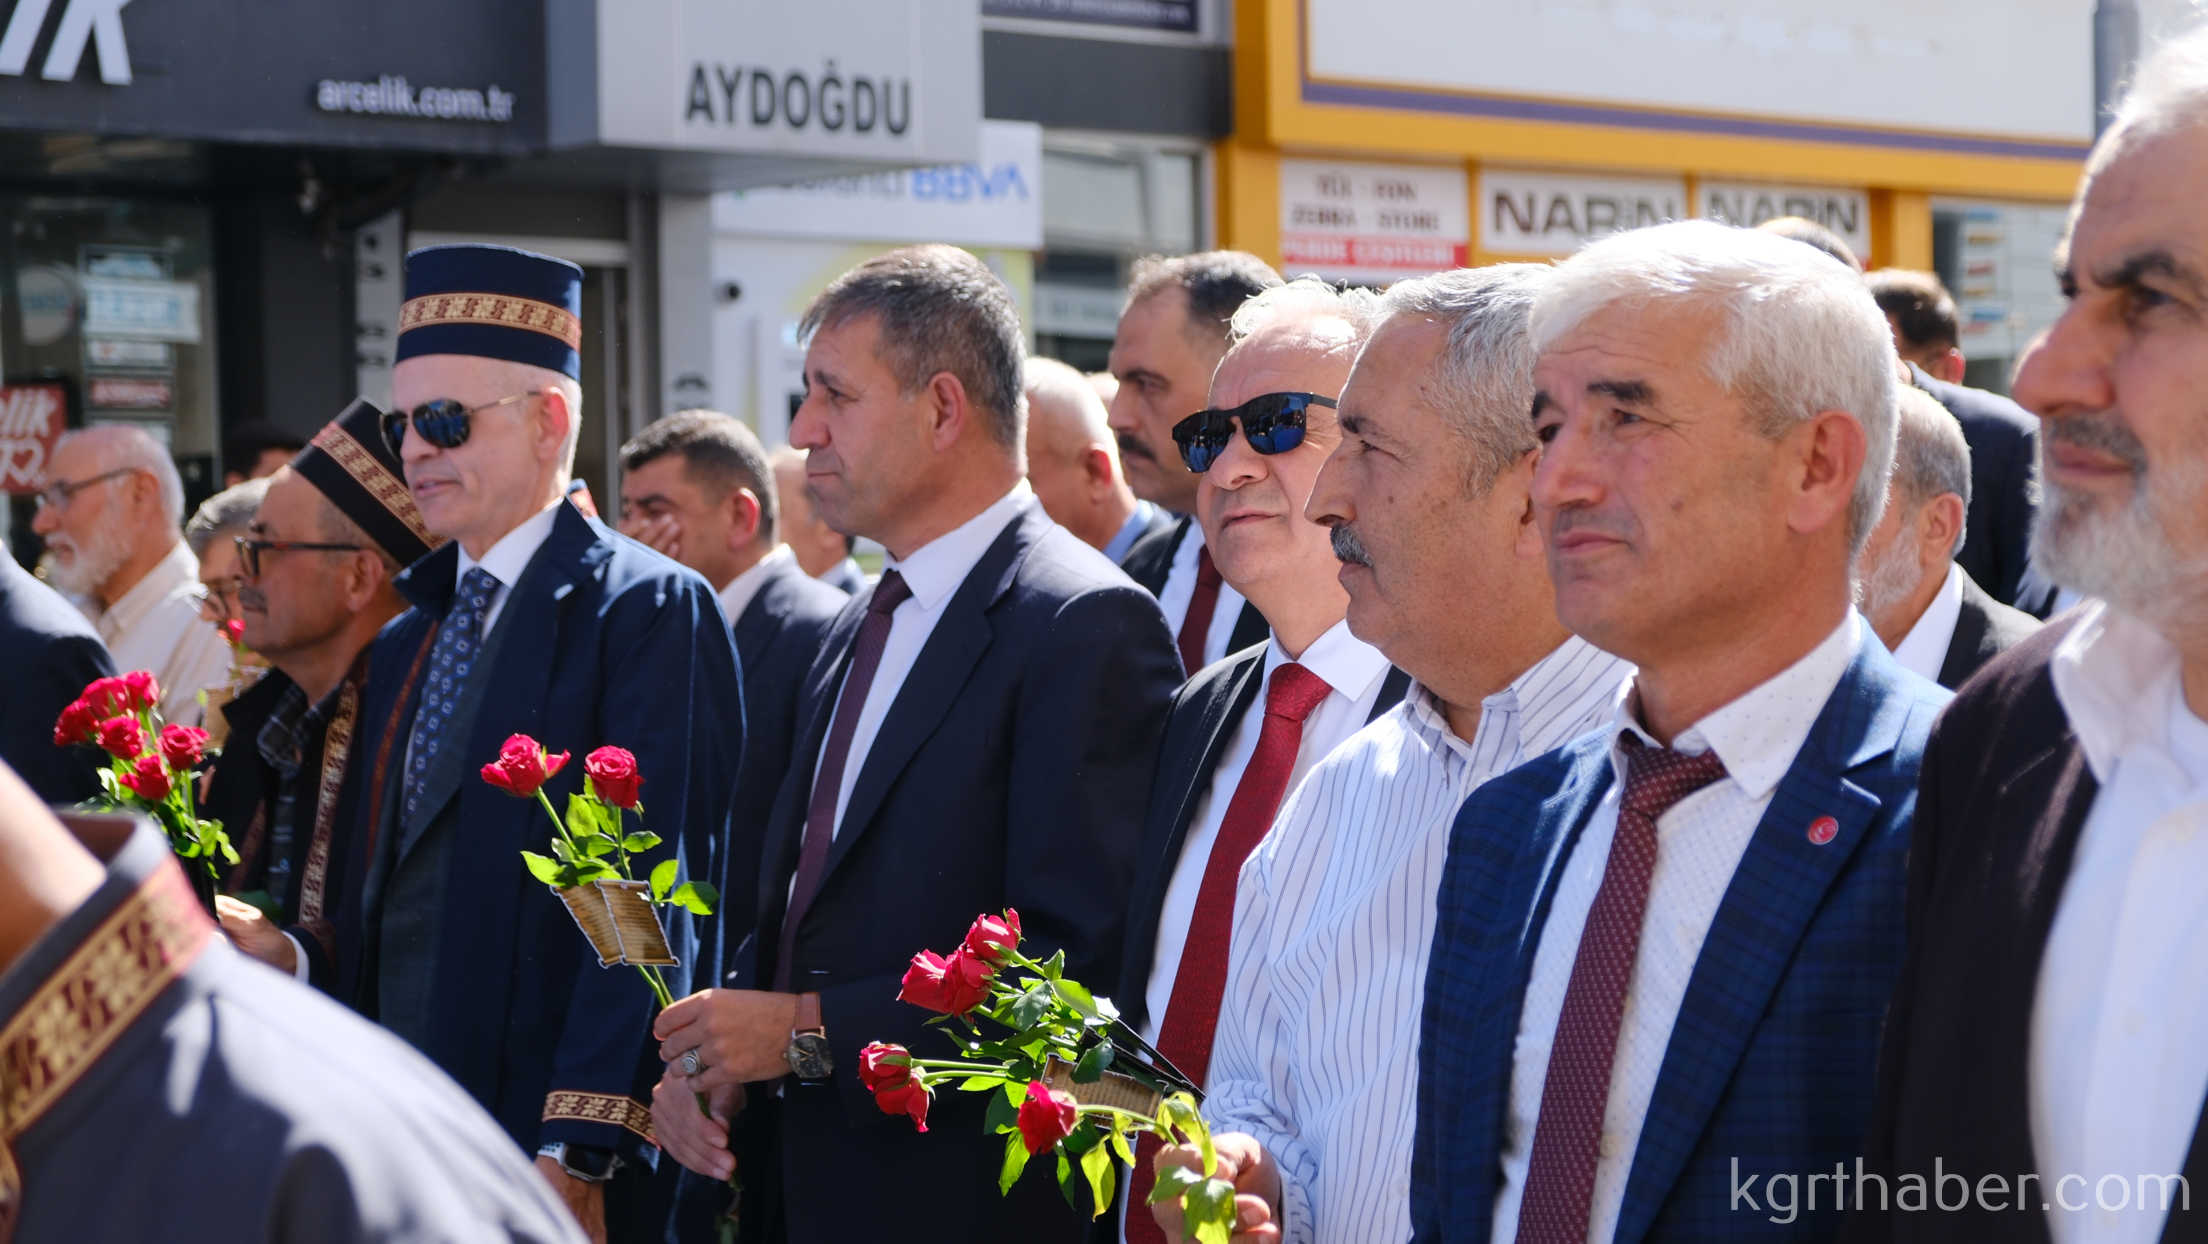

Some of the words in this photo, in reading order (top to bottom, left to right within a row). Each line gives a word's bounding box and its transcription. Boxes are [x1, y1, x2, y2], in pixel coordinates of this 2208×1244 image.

[318, 74, 516, 122] arcelik.com.tr
[684, 58, 911, 136] AYDOĞDU
[911, 163, 1030, 201] BBVA
